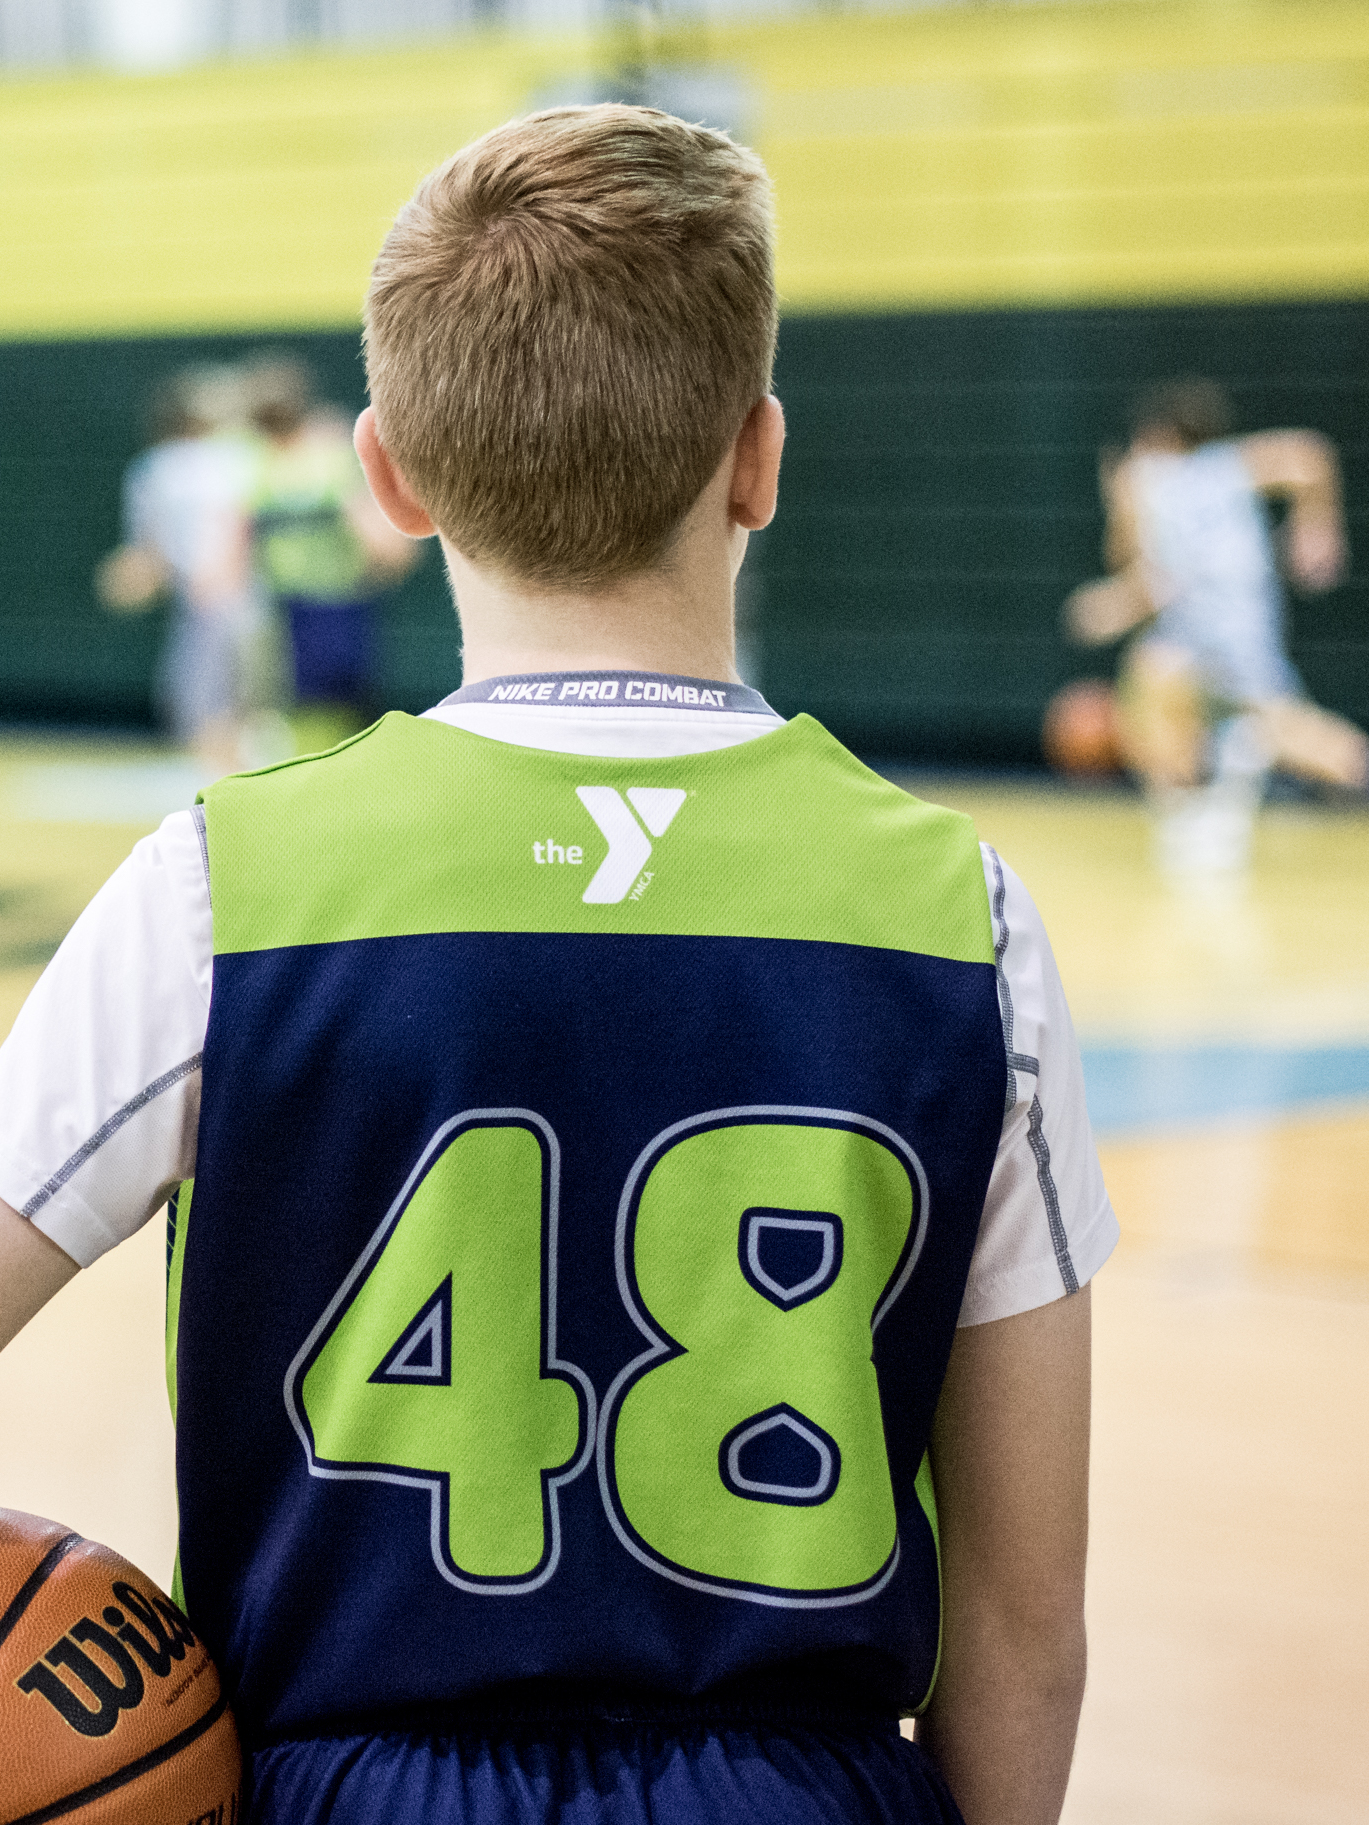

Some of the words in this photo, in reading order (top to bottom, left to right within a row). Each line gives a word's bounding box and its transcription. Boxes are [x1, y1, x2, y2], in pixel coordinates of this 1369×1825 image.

[488, 683, 556, 701] NIKE
[558, 681, 619, 701] PRO
[624, 681, 726, 707] COMBAT
[532, 839, 583, 865] the
[629, 871, 655, 901] YMCA
[283, 1105, 930, 1609] 48
[15, 1580, 197, 1738] Wils
